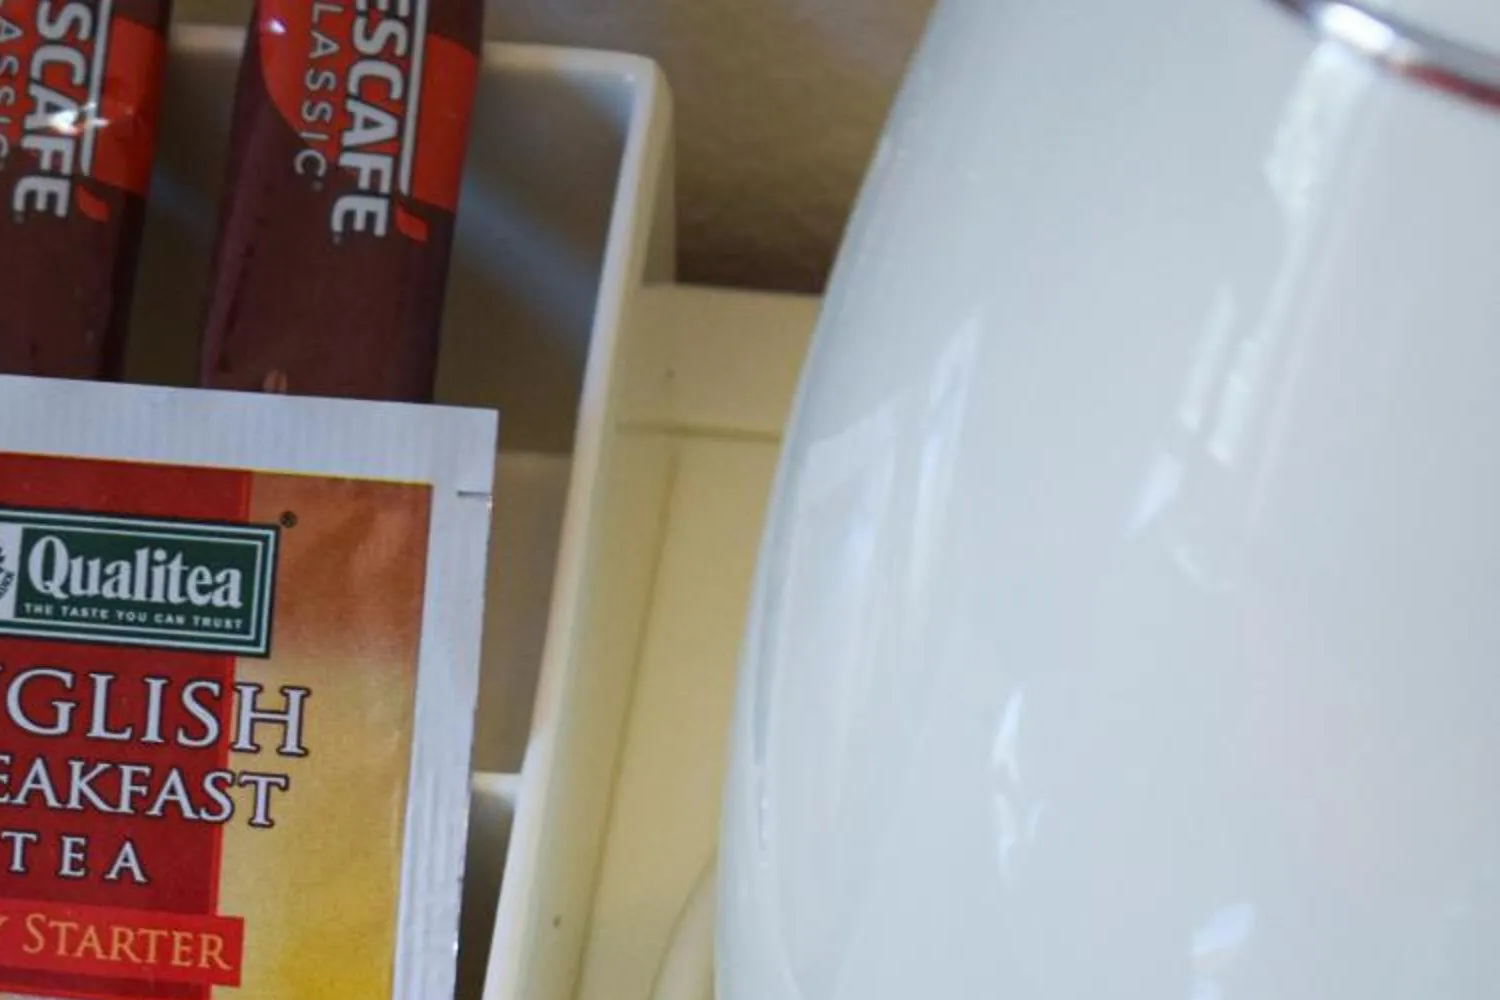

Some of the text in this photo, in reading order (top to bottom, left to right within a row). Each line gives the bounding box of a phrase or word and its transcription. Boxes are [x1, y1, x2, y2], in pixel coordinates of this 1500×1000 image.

[27, 534, 243, 610] Qualitea
[24, 602, 54, 616] THE
[60, 605, 110, 620] TASTE
[116, 609, 148, 623] YOU
[192, 615, 244, 630] TRUST
[0, 830, 149, 885] TEA
[22, 912, 234, 971] STARTER
